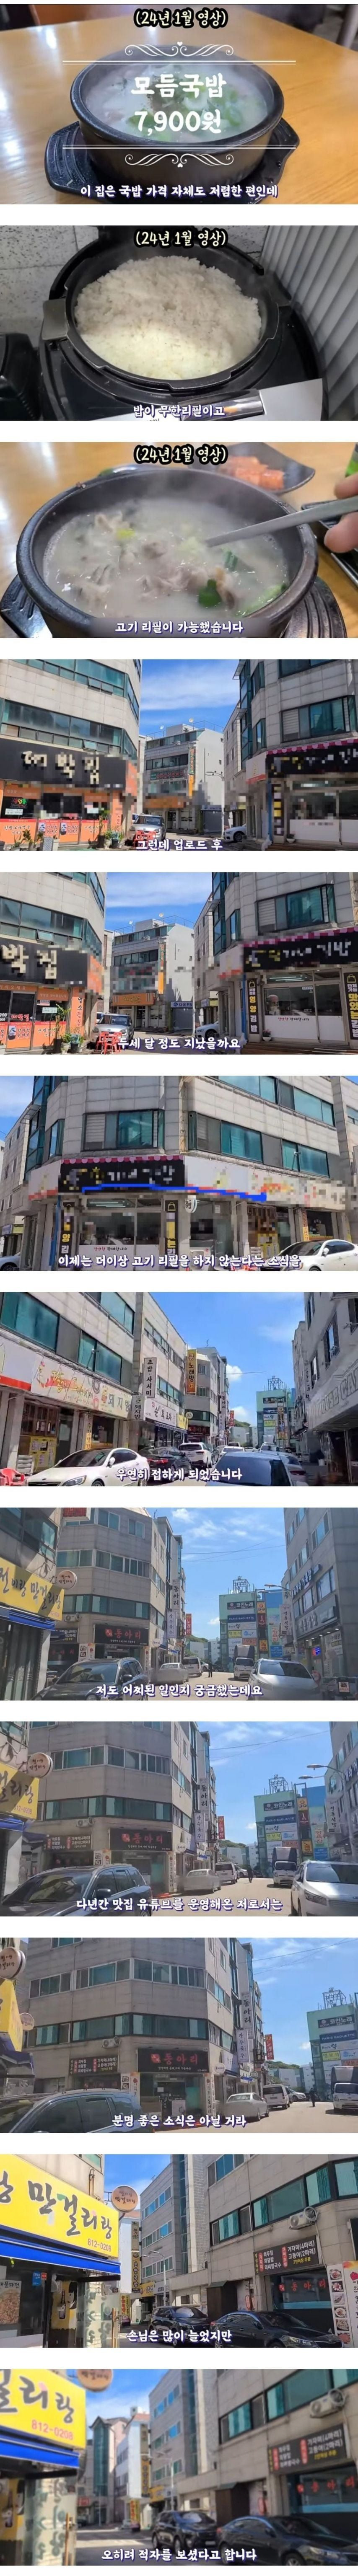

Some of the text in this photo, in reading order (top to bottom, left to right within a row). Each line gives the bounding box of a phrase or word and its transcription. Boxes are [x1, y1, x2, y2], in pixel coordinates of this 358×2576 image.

[31, 1582, 61, 1610] 막걸리랑
[114, 1629, 141, 1640] 동아리
[132, 1833, 163, 1844] 동아리
[243, 1999, 252, 2023] 동아리
[329, 2016, 353, 2025] 코인노래
[163, 2054, 198, 2065] 동아리
[28, 2180, 112, 2240] 막걸리랑
[88, 2239, 112, 2252] 812-0208
[287, 2240, 315, 2252] 가자미(4마리)
[288, 2248, 316, 2259] 고등어(2마리)
[291, 2279, 326, 2292] 동아리
[31, 2419, 73, 2440] 812-0208
